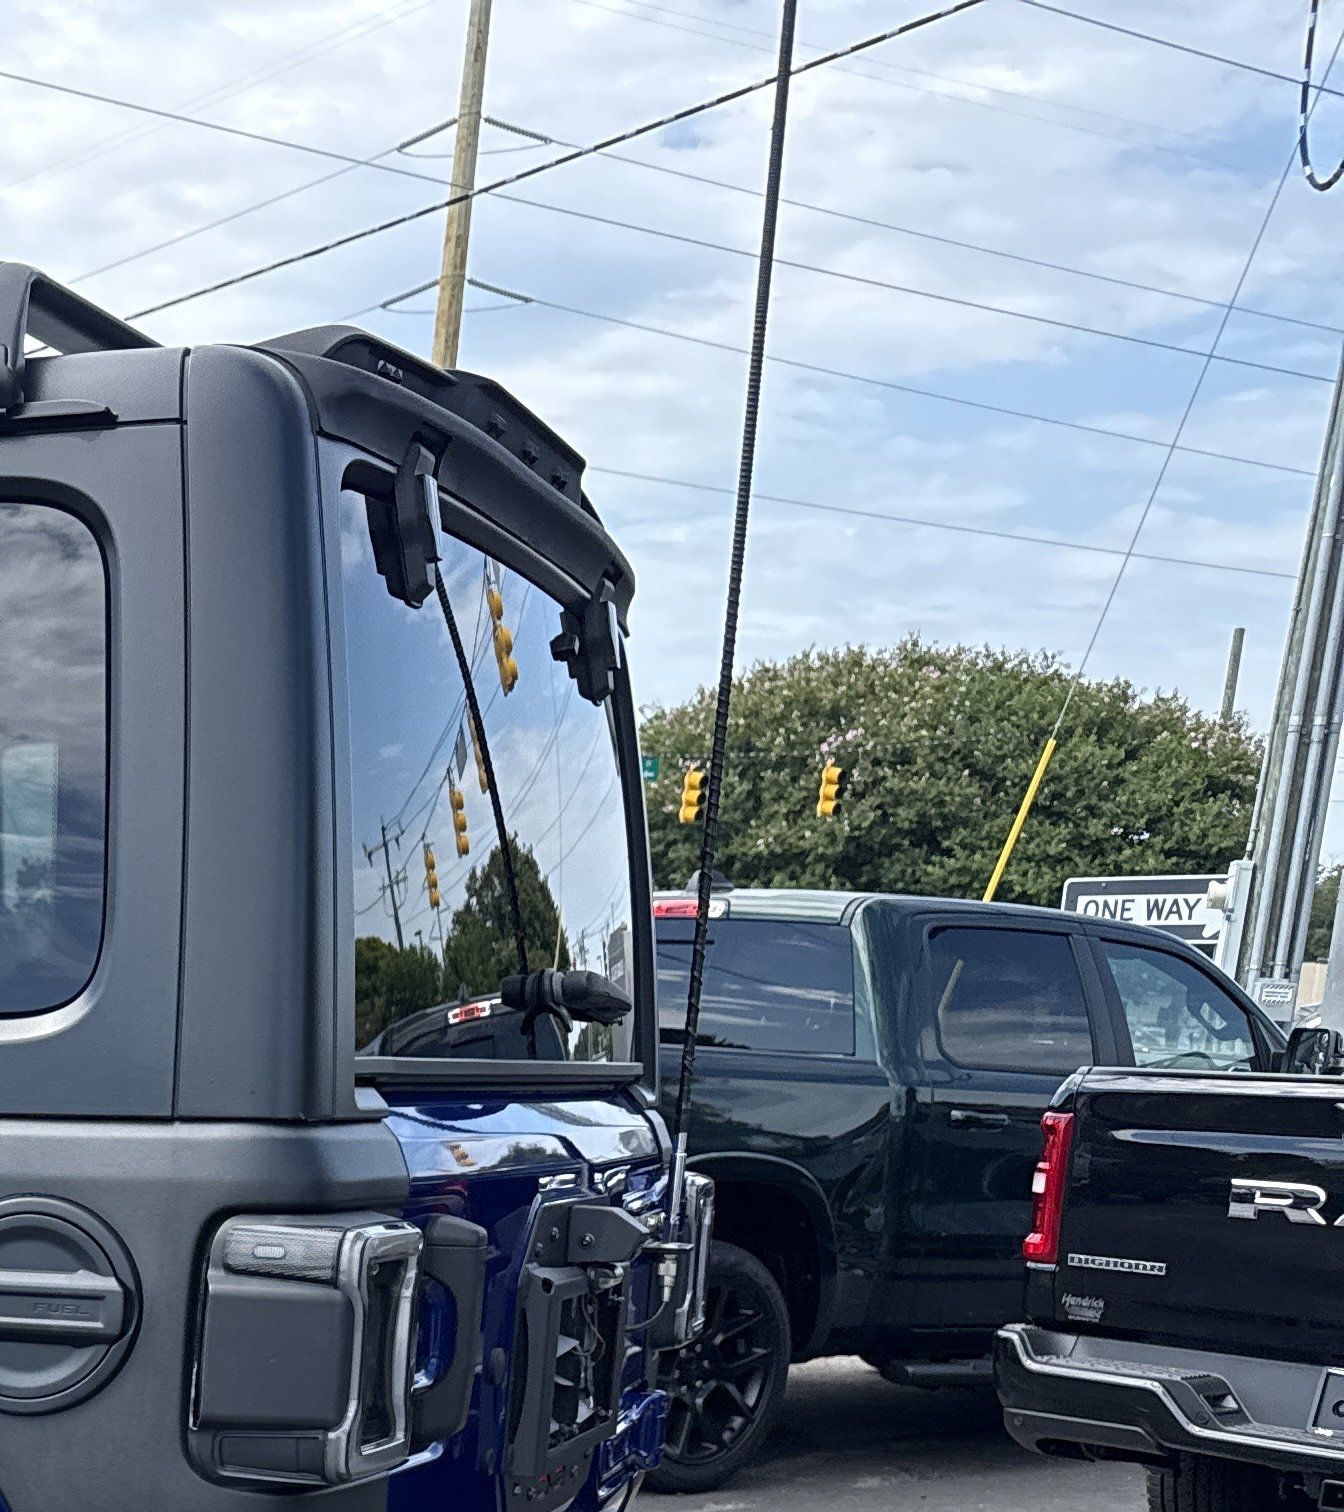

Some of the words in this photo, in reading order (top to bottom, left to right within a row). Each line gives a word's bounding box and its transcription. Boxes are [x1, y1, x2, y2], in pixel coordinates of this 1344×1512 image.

[1083, 898, 1136, 922] ONE
[1146, 897, 1202, 921] WAY
[1227, 1178, 1344, 1227] R
[31, 1302, 91, 1317] FUEL
[1061, 1292, 1105, 1309] Hendrick
